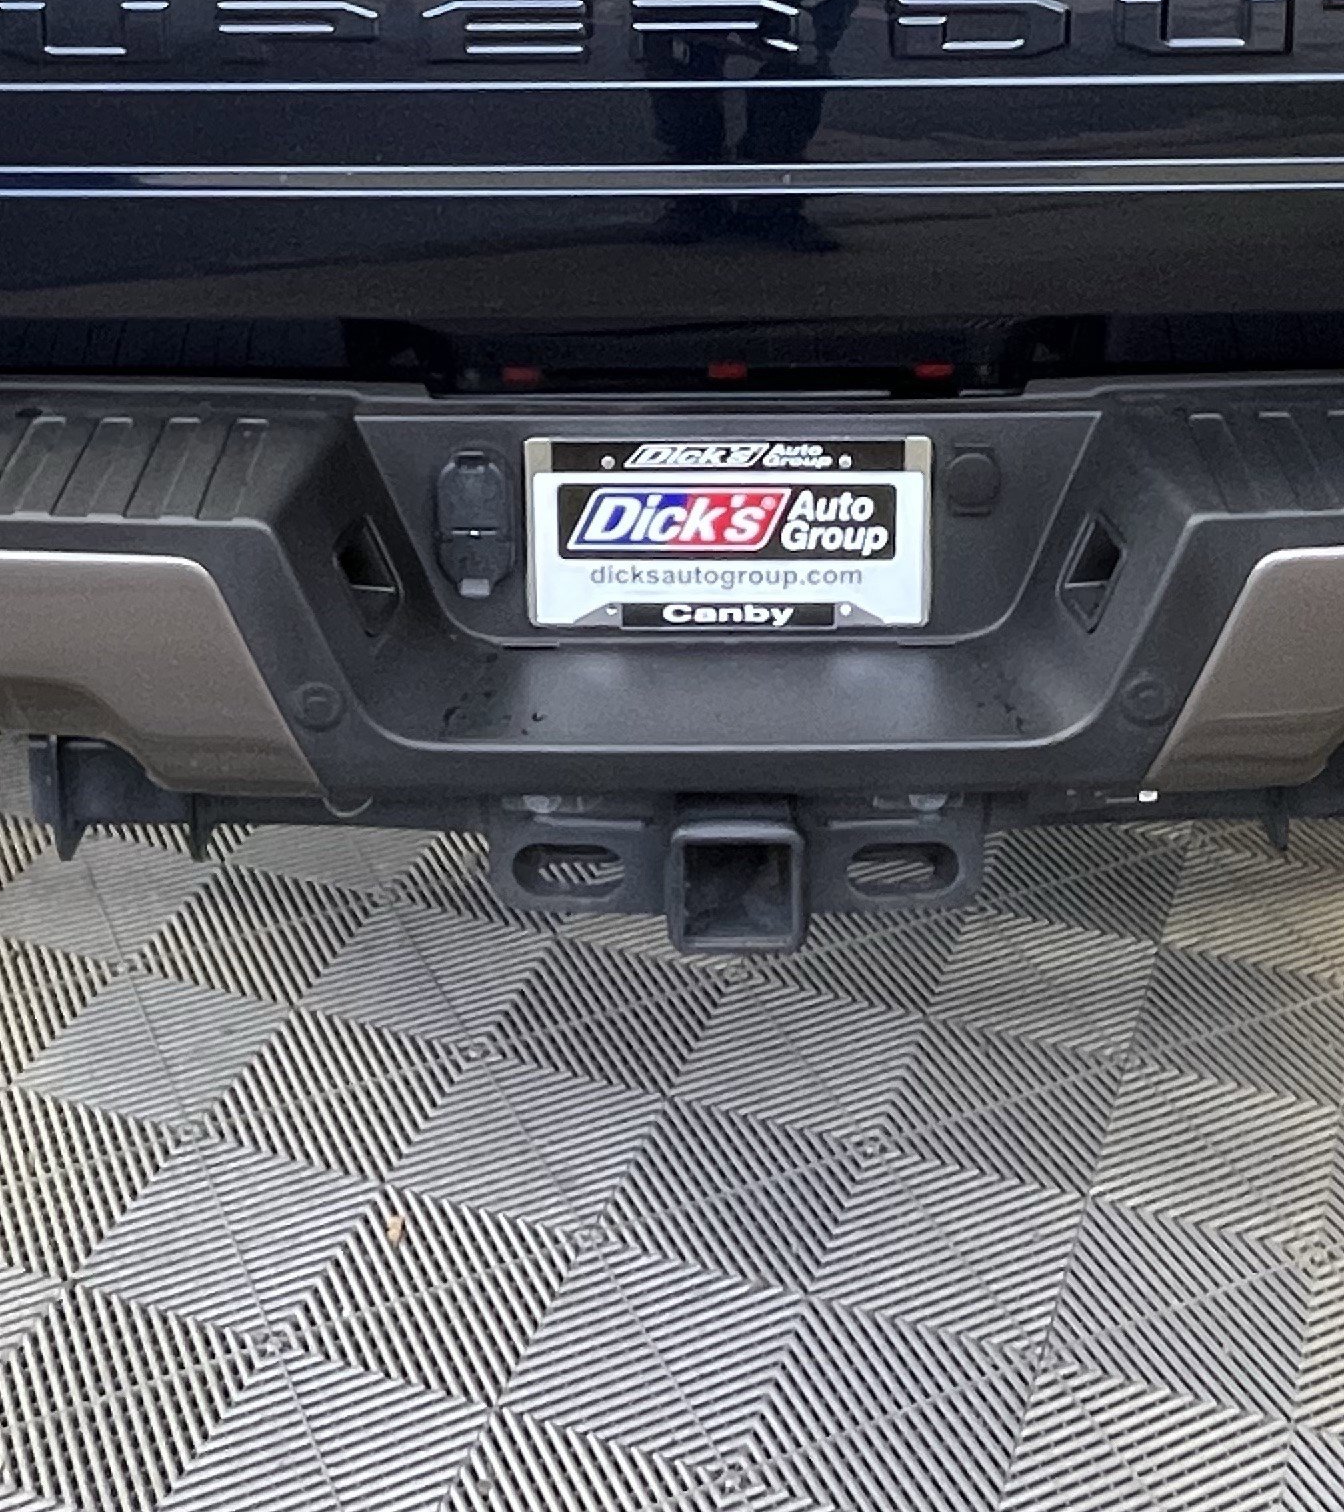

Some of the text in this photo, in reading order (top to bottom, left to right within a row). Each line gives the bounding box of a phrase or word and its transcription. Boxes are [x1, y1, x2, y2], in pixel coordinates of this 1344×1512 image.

[768, 444, 824, 456] Auto
[582, 493, 767, 542] Dick's
[786, 489, 875, 523] Auto
[780, 520, 889, 556] Group
[590, 564, 864, 590] dicksautogroup.com
[661, 603, 796, 627] Canby
